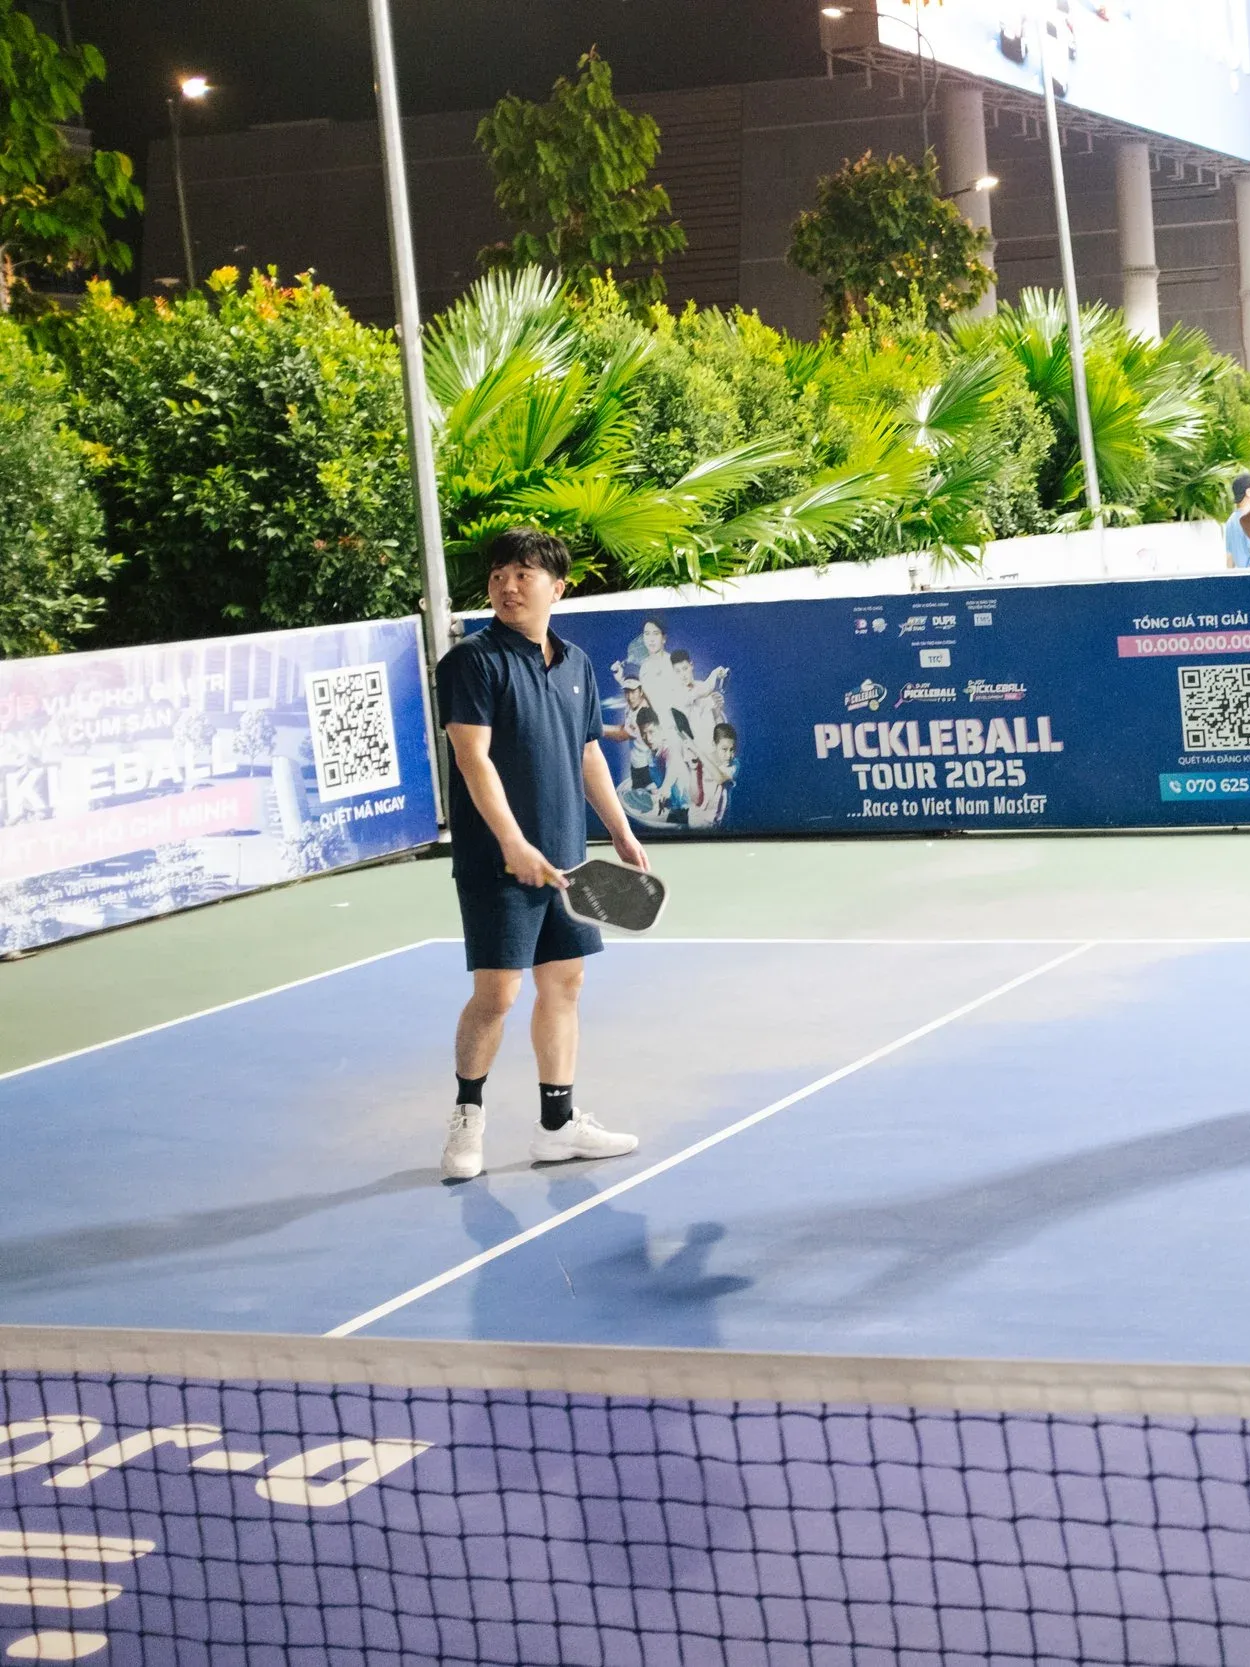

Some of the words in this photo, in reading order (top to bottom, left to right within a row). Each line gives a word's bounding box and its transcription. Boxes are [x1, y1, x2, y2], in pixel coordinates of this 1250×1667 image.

[1133, 614, 1169, 630] TỔNG
[1172, 613, 1195, 628] GIÁ
[1197, 615, 1218, 629] TRỊ
[1221, 611, 1248, 626] GIẢI
[904, 688, 957, 699] PICKLEBALL
[126, 707, 171, 731] SÂN
[814, 716, 1064, 759] PICKLEBALL
[1178, 754, 1201, 766] QUÉT
[851, 762, 937, 790] TOUR
[945, 759, 1026, 788] 2025
[1185, 778, 1216, 793] 070
[1220, 777, 1249, 792] 625
[178, 798, 237, 828] MINH
[319, 806, 352, 831] QUÉT
[352, 801, 374, 822] MÃ
[374, 795, 406, 818] NGAY
[902, 799, 918, 816] to
[922, 797, 953, 816] Viet
[956, 797, 989, 815] Nam
[994, 793, 1048, 814] Master
